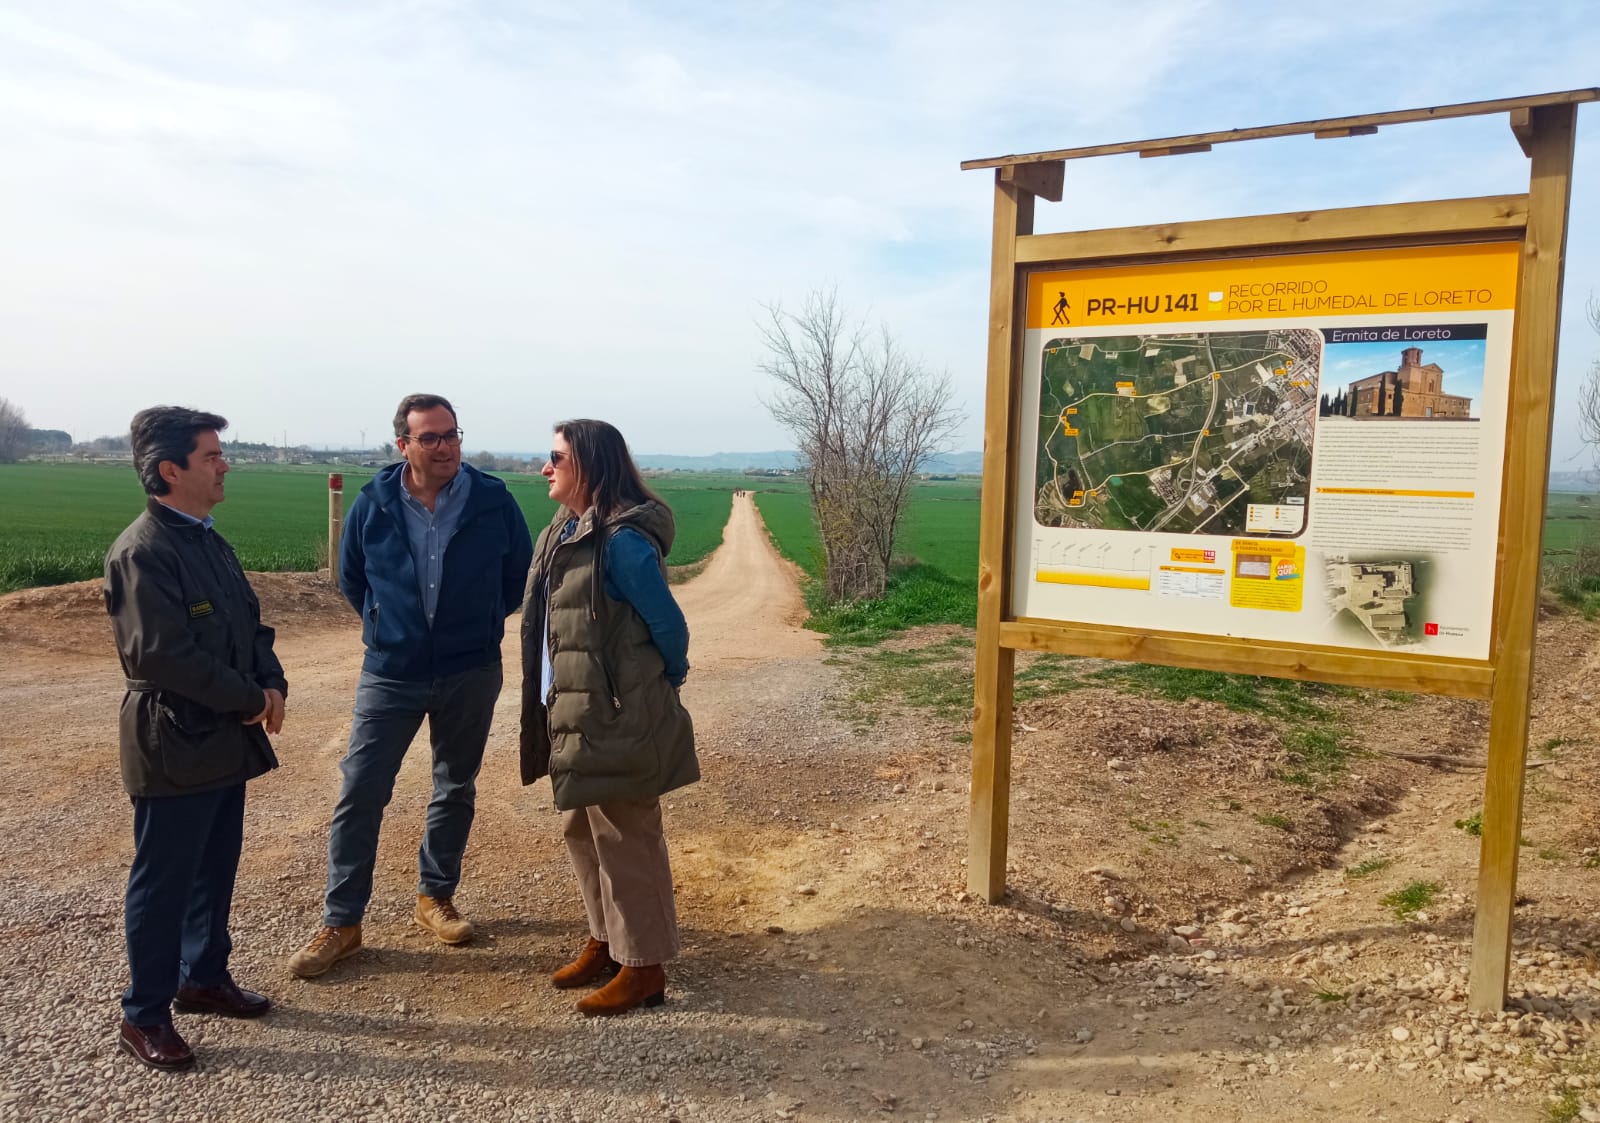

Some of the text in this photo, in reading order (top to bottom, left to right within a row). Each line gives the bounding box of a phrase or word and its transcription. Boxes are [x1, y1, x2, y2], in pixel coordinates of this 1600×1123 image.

[1228, 280, 1328, 298] RECORRIDO
[1087, 293, 1199, 317] PR-HU 141
[1227, 288, 1493, 313] POR EL HUMEDAL DE LORETO
[1332, 328, 1451, 342] Ermita de Loreto
